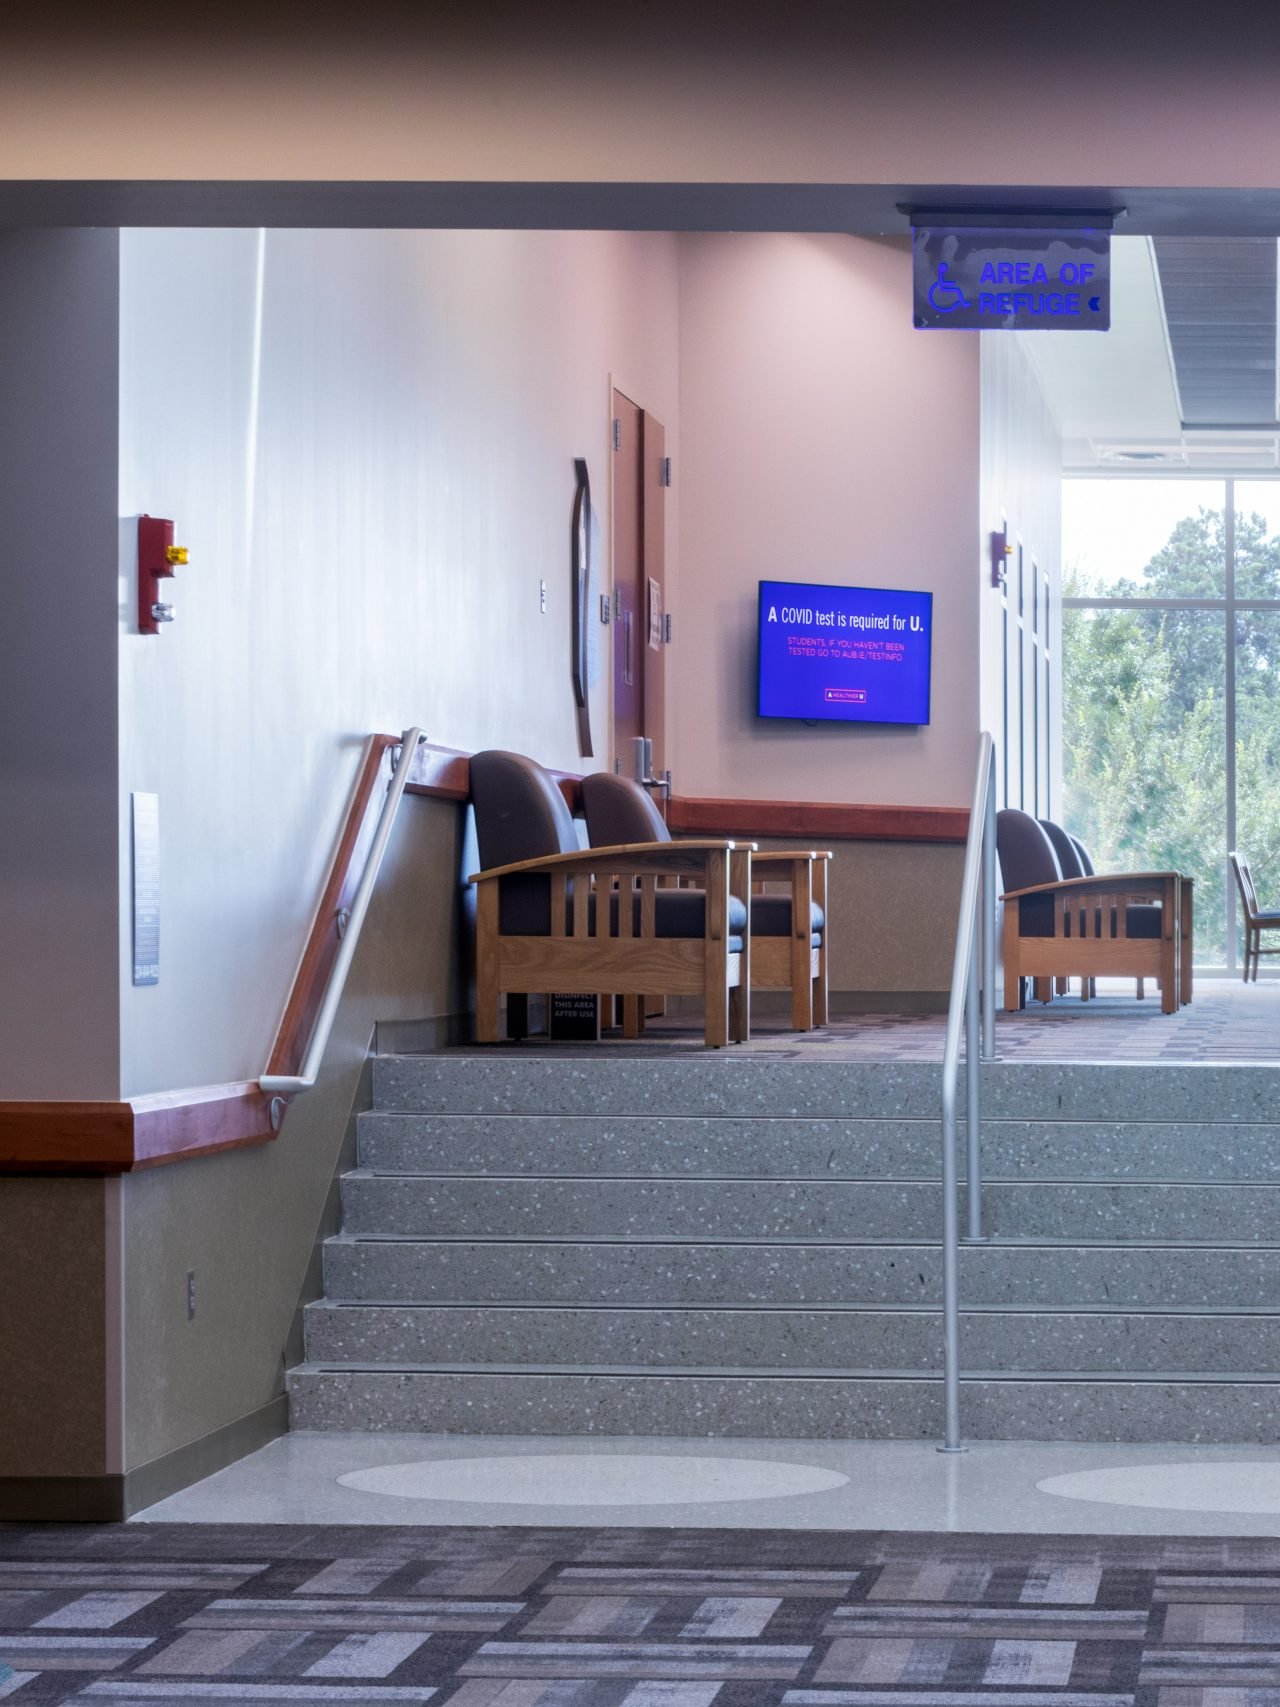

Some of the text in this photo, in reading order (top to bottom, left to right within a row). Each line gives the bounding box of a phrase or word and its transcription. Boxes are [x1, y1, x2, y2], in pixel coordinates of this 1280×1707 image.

[980, 262, 1095, 286] AREA OF
[978, 293, 1081, 315] REFUGE
[767, 606, 924, 632] A COVID test is required for U.
[837, 640, 852, 648] YOU
[853, 641, 884, 650] HAVEN'T
[885, 642, 905, 651] BEEN
[788, 647, 816, 656] TESTED
[817, 648, 829, 657] GO
[831, 649, 841, 658] TO
[554, 1001, 595, 1009] THIS AREA
[579, 1010, 595, 1018] USE
